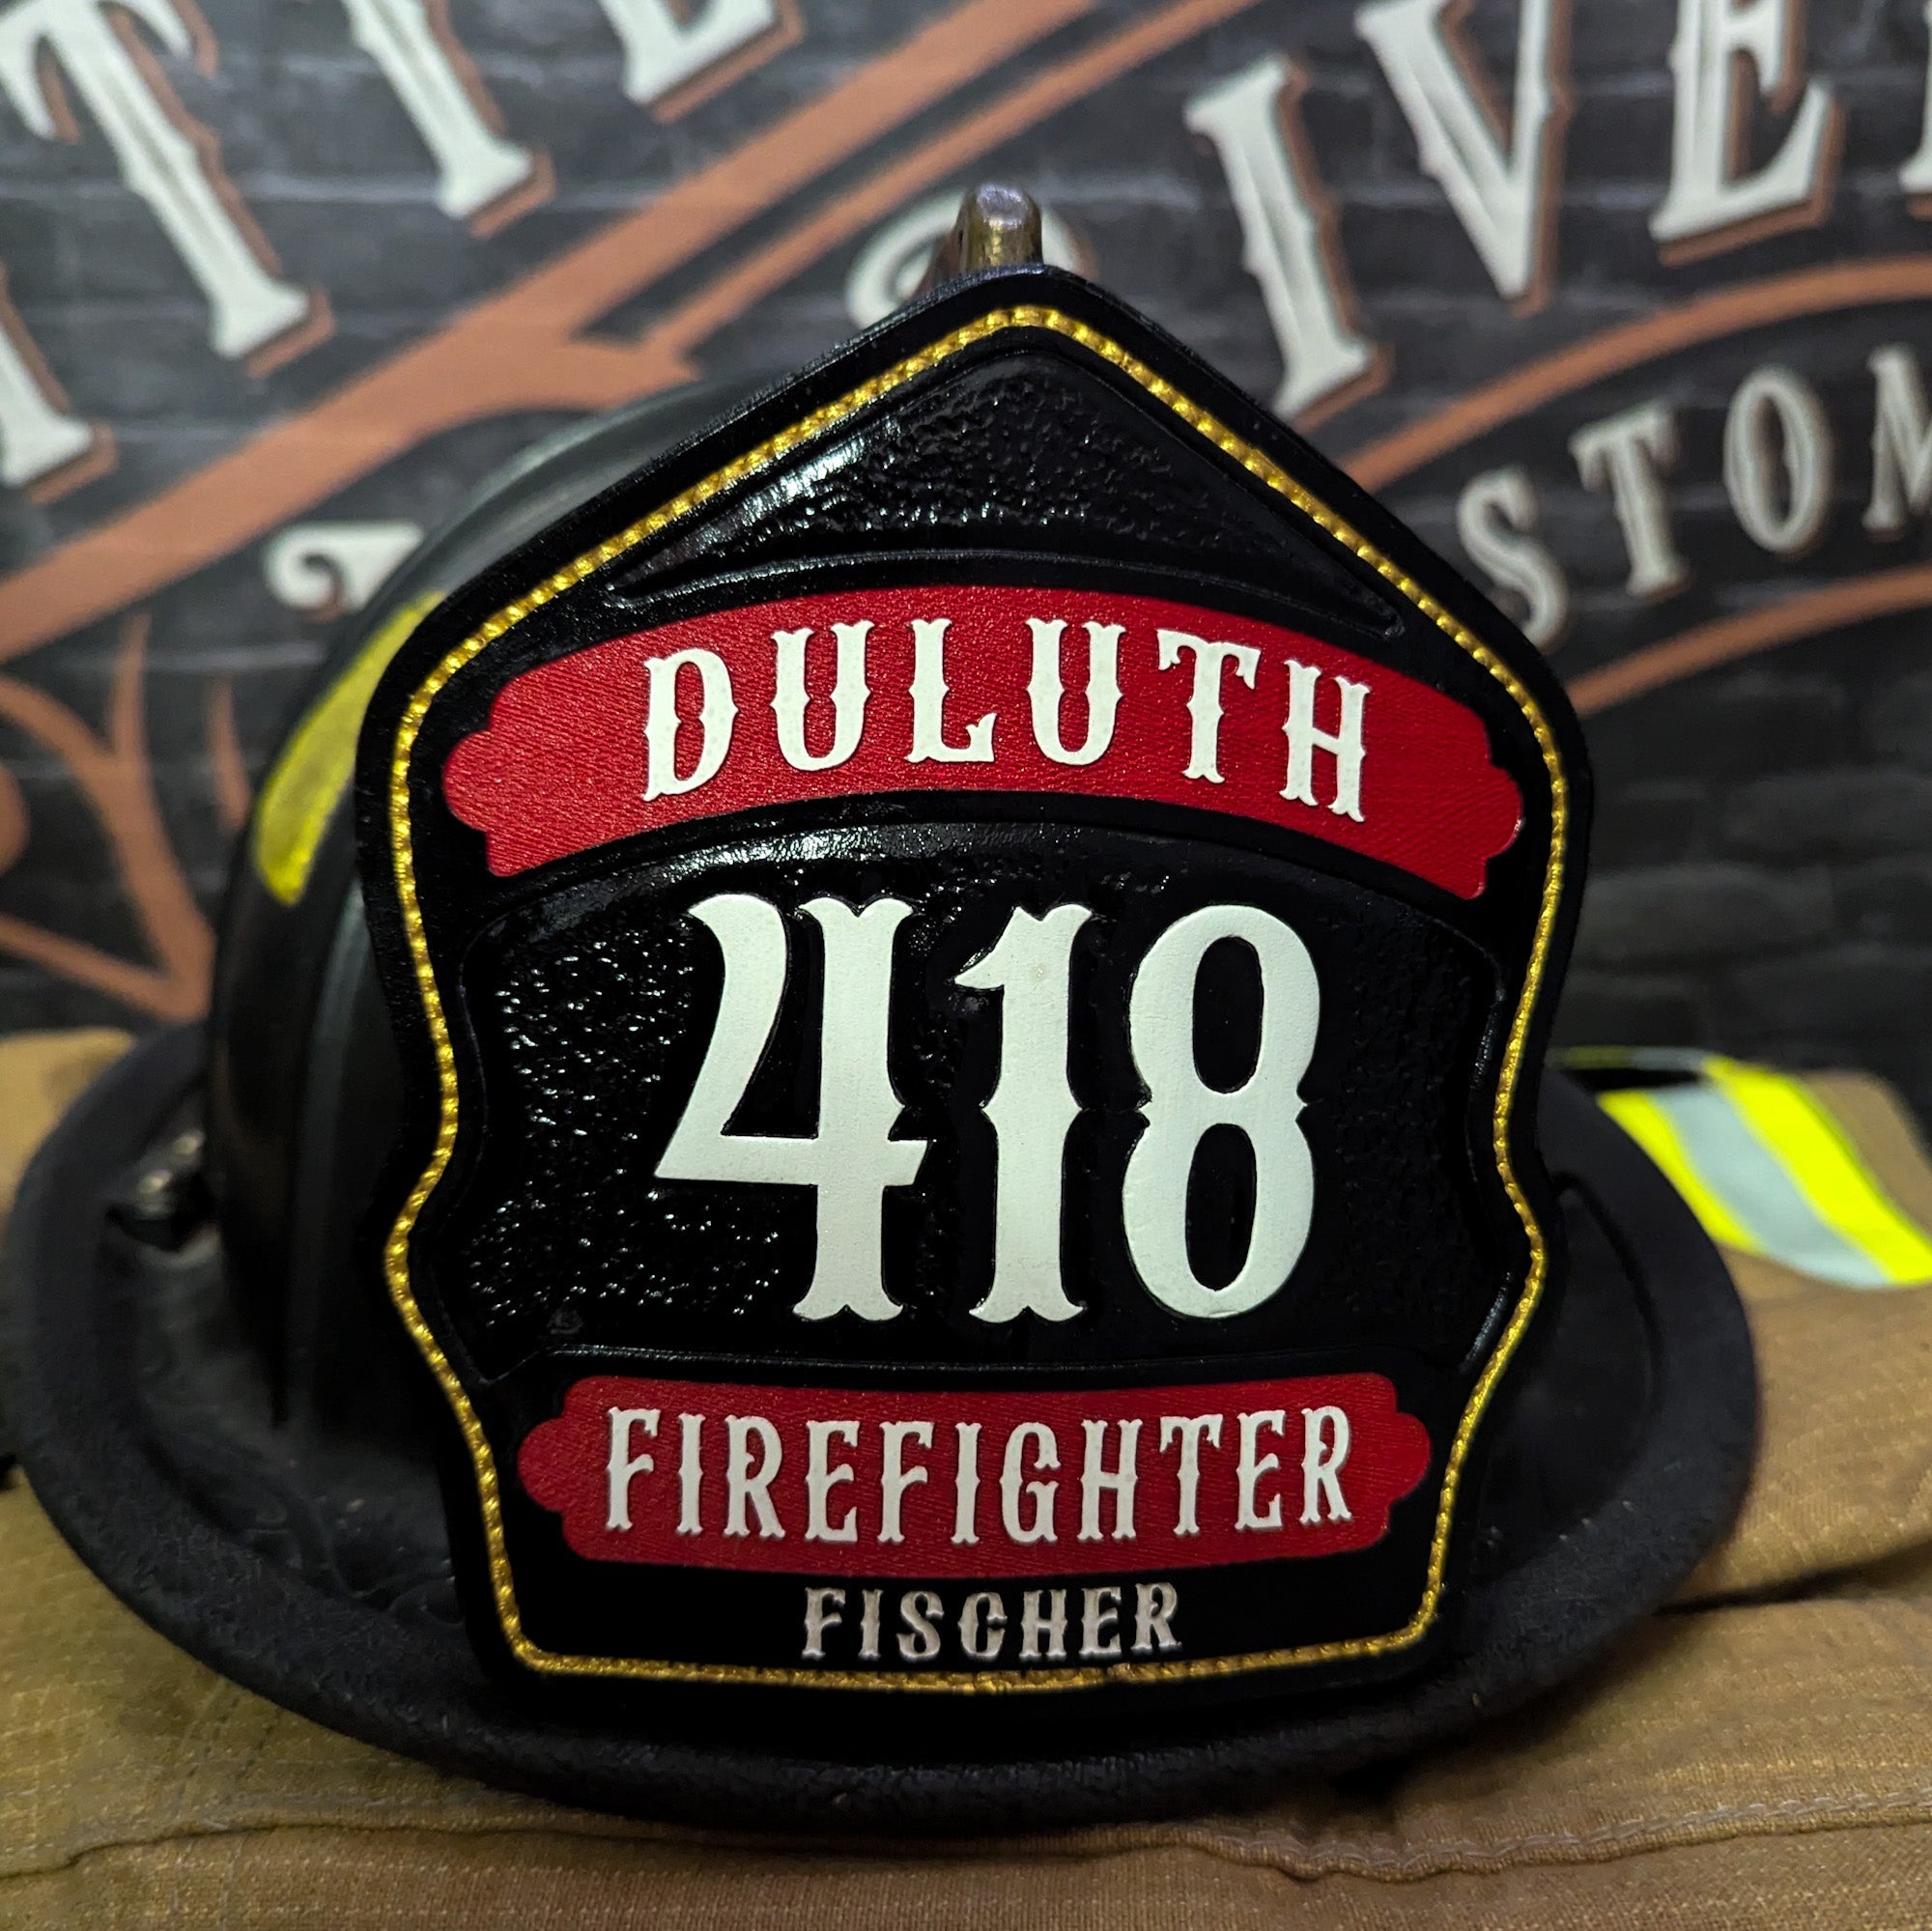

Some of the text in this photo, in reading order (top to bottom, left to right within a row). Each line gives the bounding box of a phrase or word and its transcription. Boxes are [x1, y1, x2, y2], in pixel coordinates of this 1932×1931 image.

[639, 614, 1371, 823] DULUTH
[656, 894, 1321, 1323] 418
[605, 1405, 1353, 1545] FIREFIGHTER
[801, 1582, 1183, 1661] FISCHER
